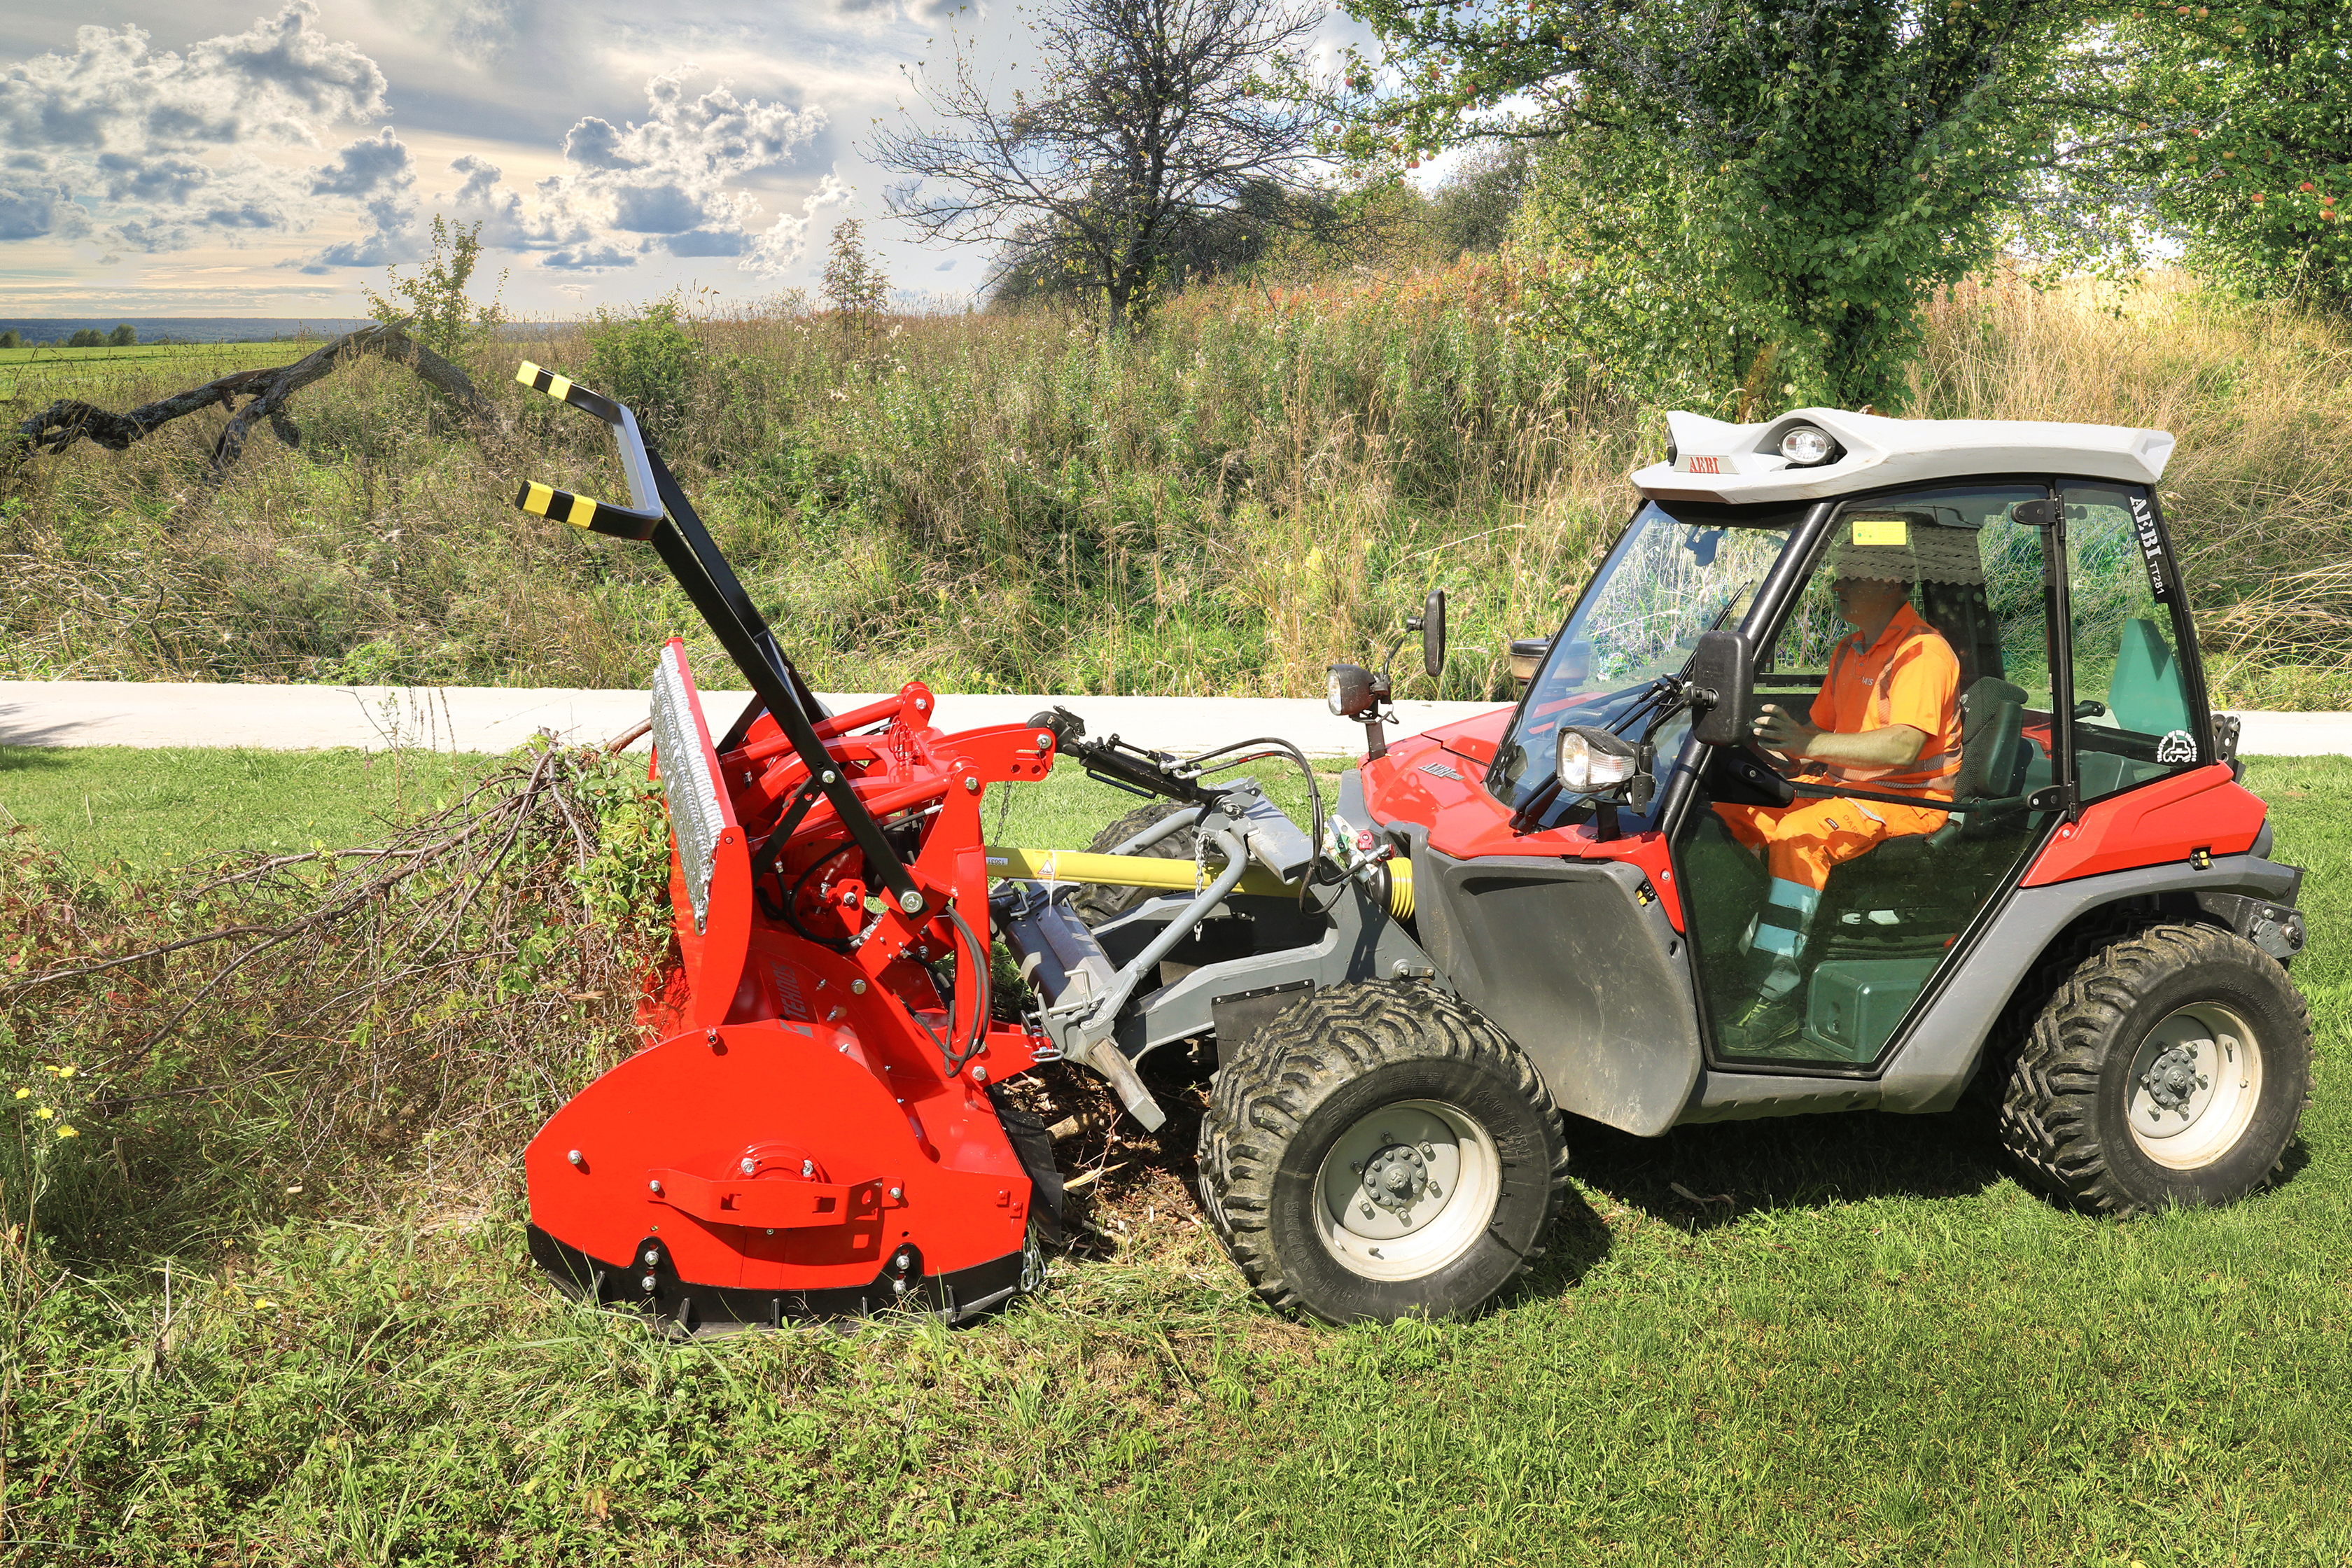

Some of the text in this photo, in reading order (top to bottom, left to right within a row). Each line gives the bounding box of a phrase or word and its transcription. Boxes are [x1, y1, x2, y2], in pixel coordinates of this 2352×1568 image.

[1689, 456, 1720, 473] AEBI
[2129, 496, 2164, 594] AEBI TT281
[1842, 815, 1861, 838] DARS
[771, 960, 808, 1020] TEHNOS
[1324, 1079, 1379, 1133] BKT
[1284, 1201, 1366, 1311] TRAC SUPER
